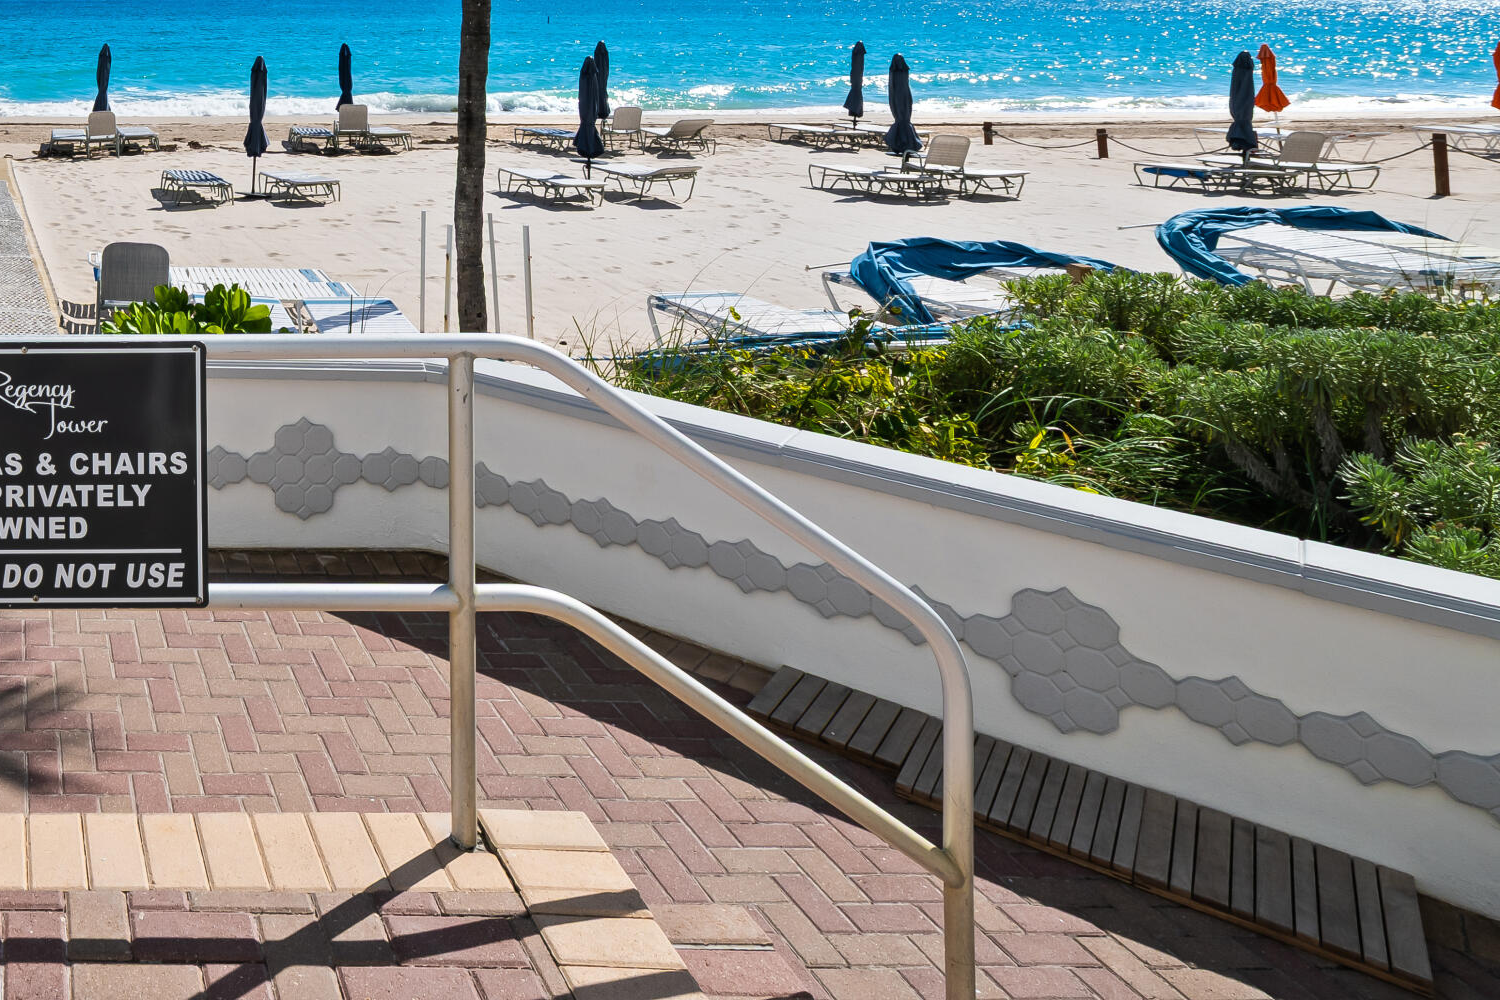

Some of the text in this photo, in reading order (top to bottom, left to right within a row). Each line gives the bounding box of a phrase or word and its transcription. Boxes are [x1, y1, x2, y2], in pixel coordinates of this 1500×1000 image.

[24, 397, 109, 440] Tower
[35, 452, 57, 476] &
[69, 452, 188, 475] CHAIRS
[2, 563, 44, 589] DO
[54, 563, 117, 589] NOT
[126, 562, 186, 588] USE
